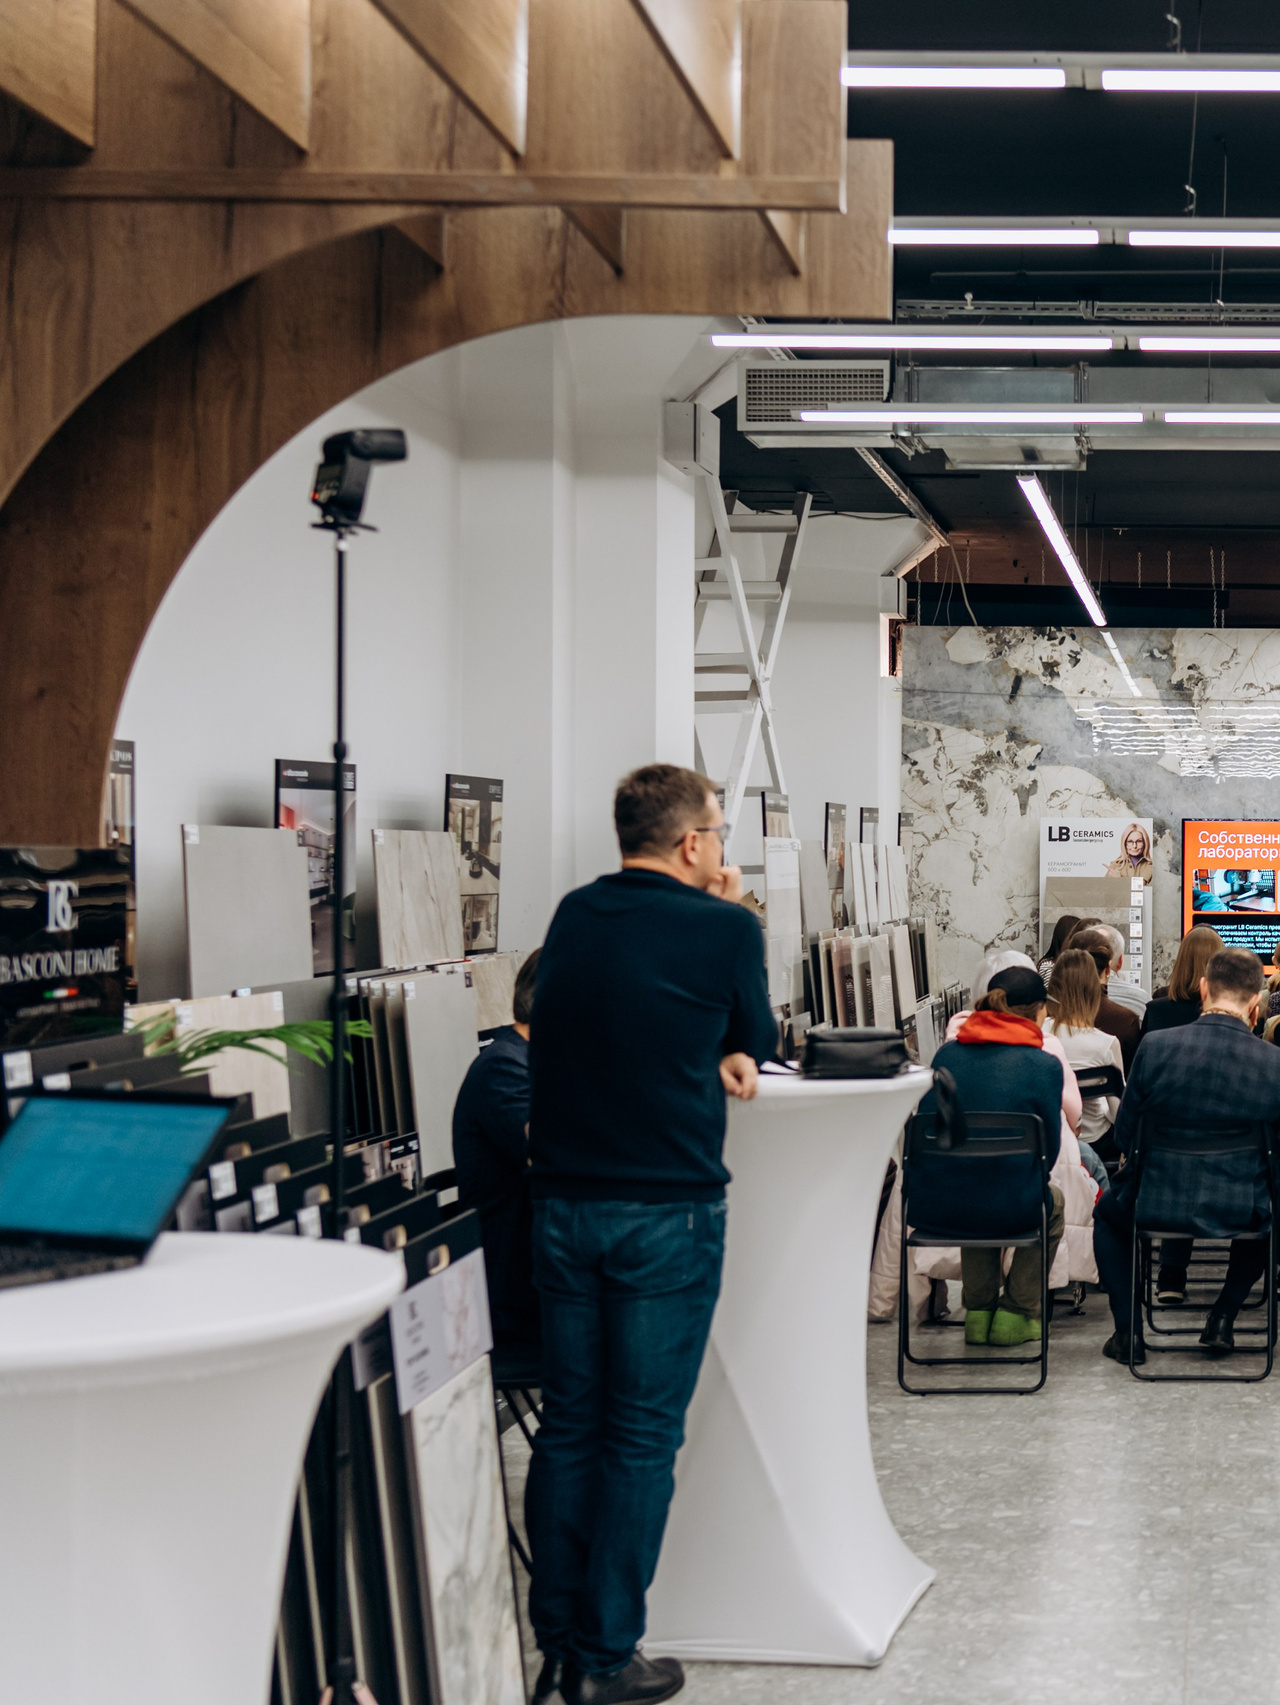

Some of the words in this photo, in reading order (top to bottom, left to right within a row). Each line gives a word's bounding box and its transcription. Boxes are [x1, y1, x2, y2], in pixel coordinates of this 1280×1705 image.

[1048, 826, 1071, 842] LB
[1073, 830, 1114, 838] CERAMICS
[0, 951, 72, 983] BASCONI
[74, 947, 119, 975] HOME
